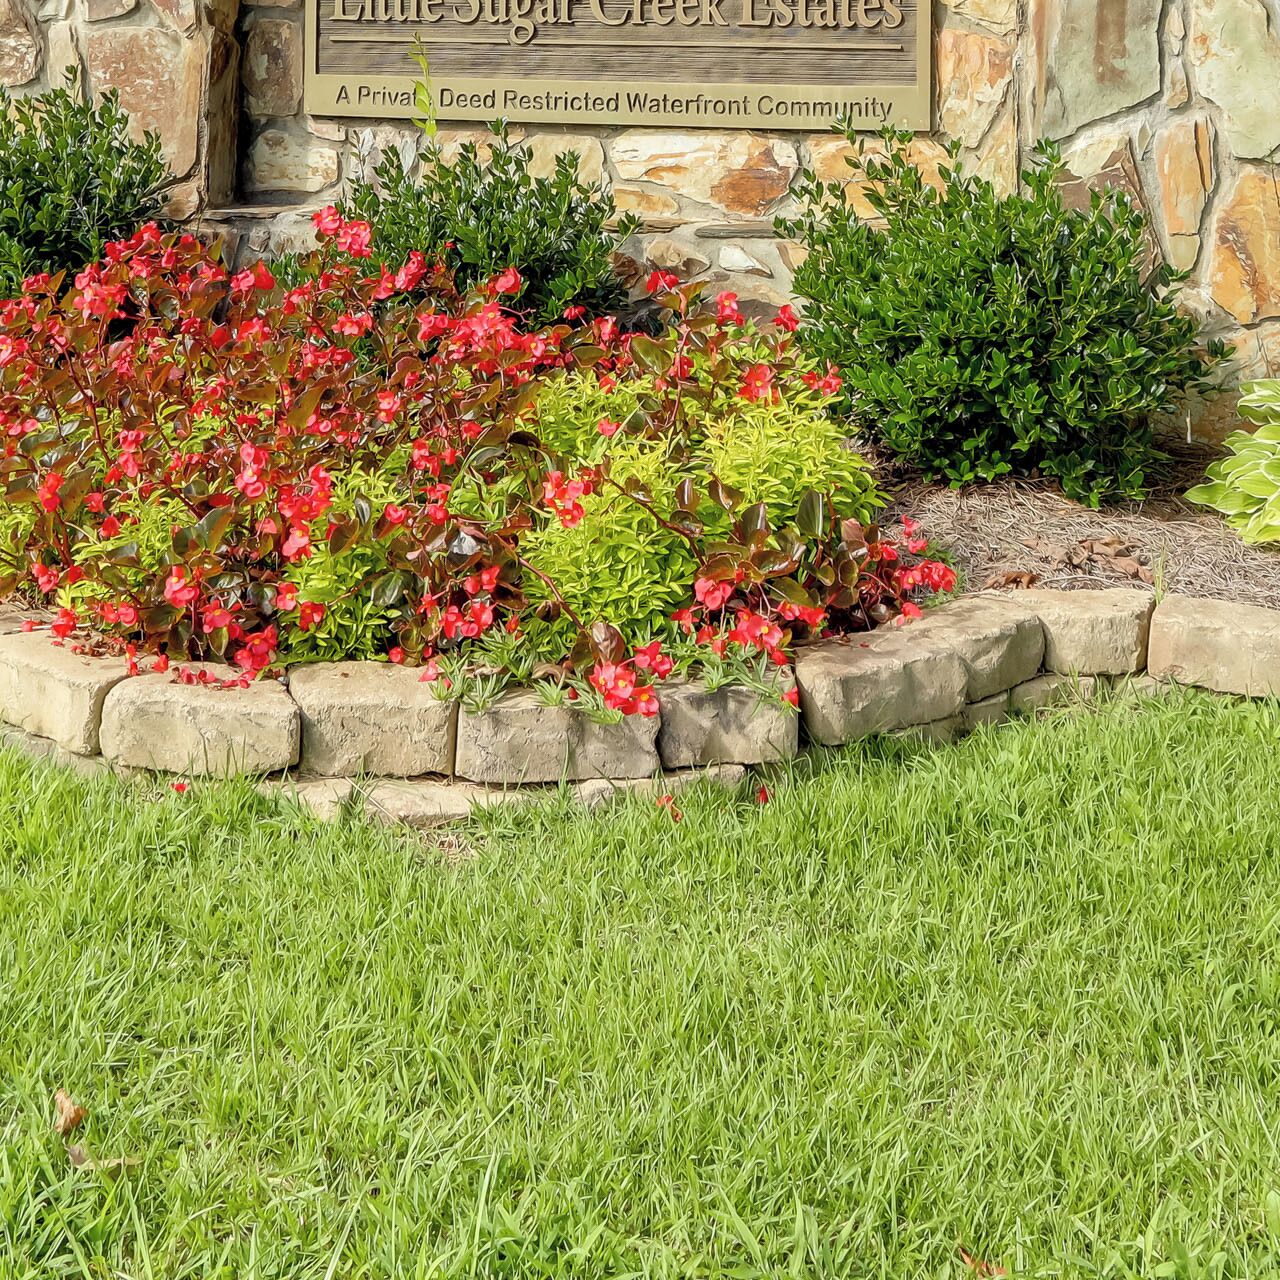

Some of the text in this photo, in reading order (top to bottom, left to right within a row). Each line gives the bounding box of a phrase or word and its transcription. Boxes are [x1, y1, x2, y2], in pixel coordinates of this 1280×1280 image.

[335, 85, 893, 123] A Privat Deed Restricted Waterfront Community
